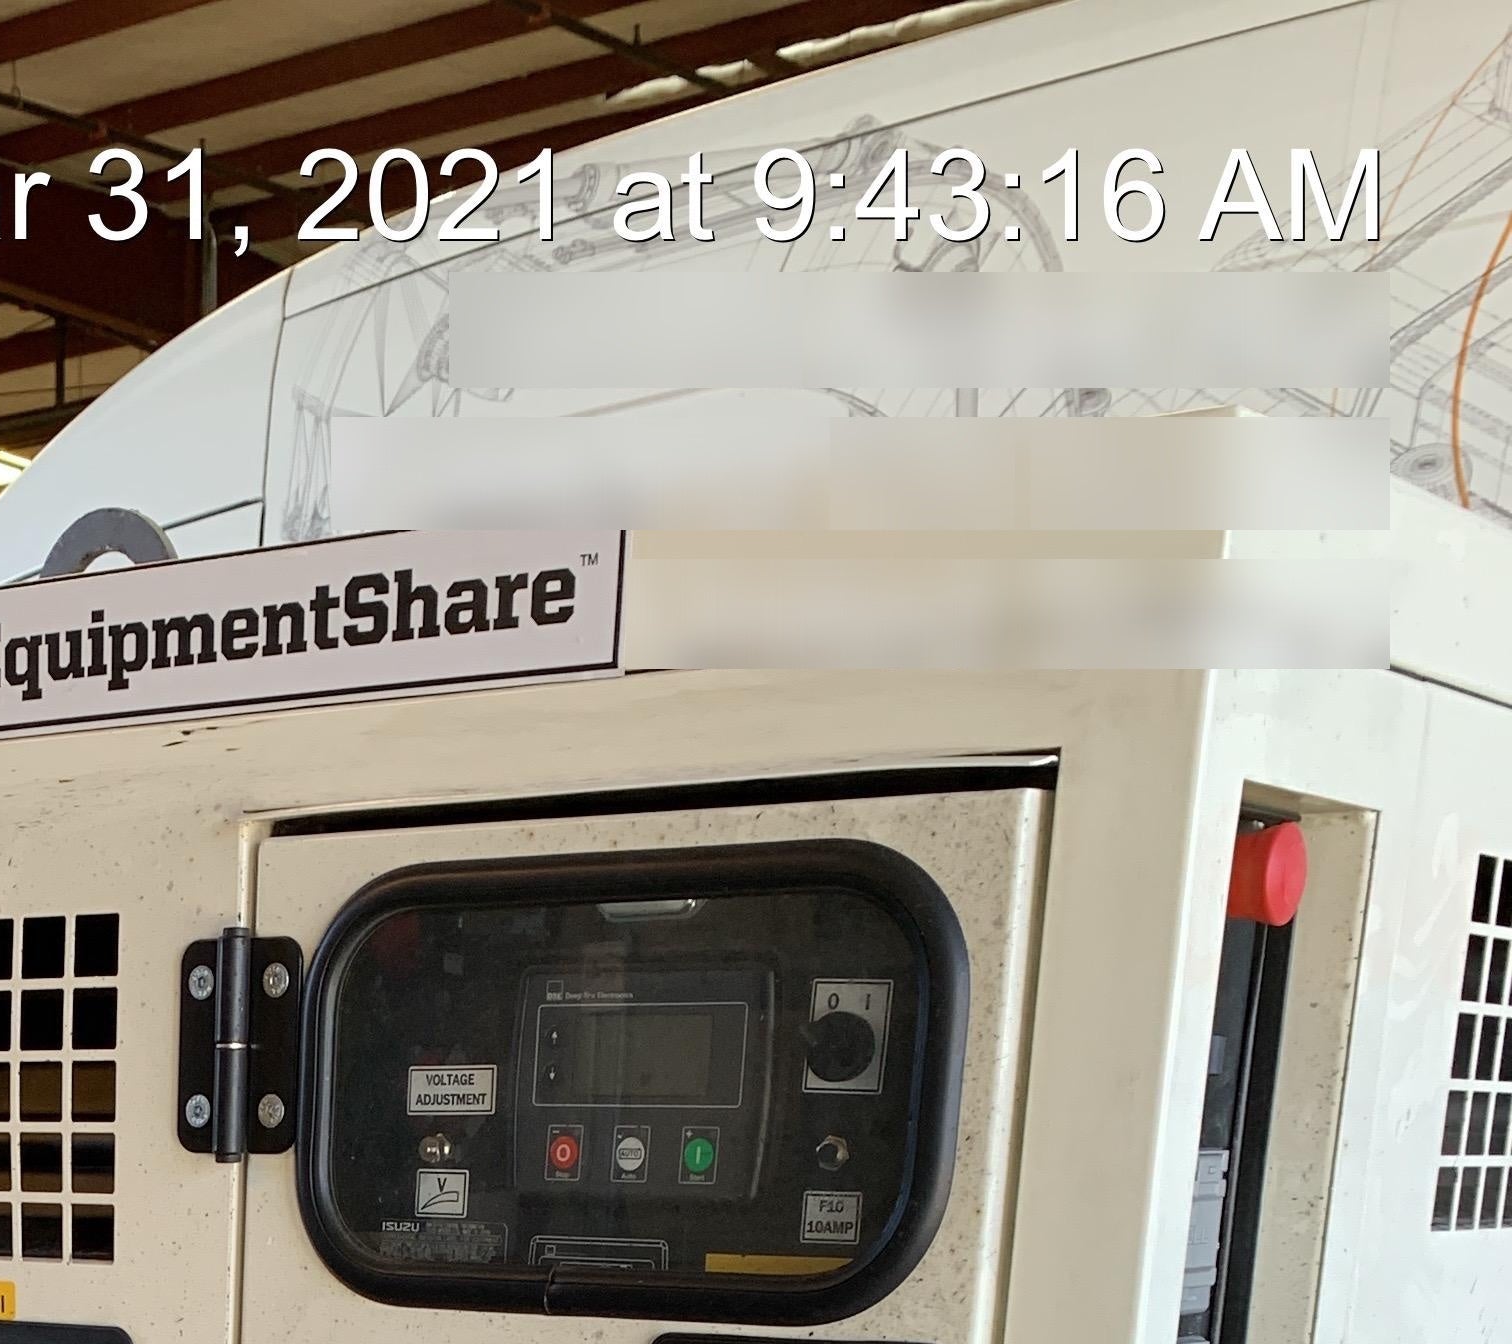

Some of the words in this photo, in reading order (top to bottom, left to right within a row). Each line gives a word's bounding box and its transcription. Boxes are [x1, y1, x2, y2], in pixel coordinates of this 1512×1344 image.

[425, 1073, 475, 1086] VOLTAGE
[415, 1092, 487, 1105] ADJUSTMENT
[437, 1177, 447, 1193] V
[382, 1221, 420, 1233] ISUZU
[806, 1219, 854, 1234] 10AMP
